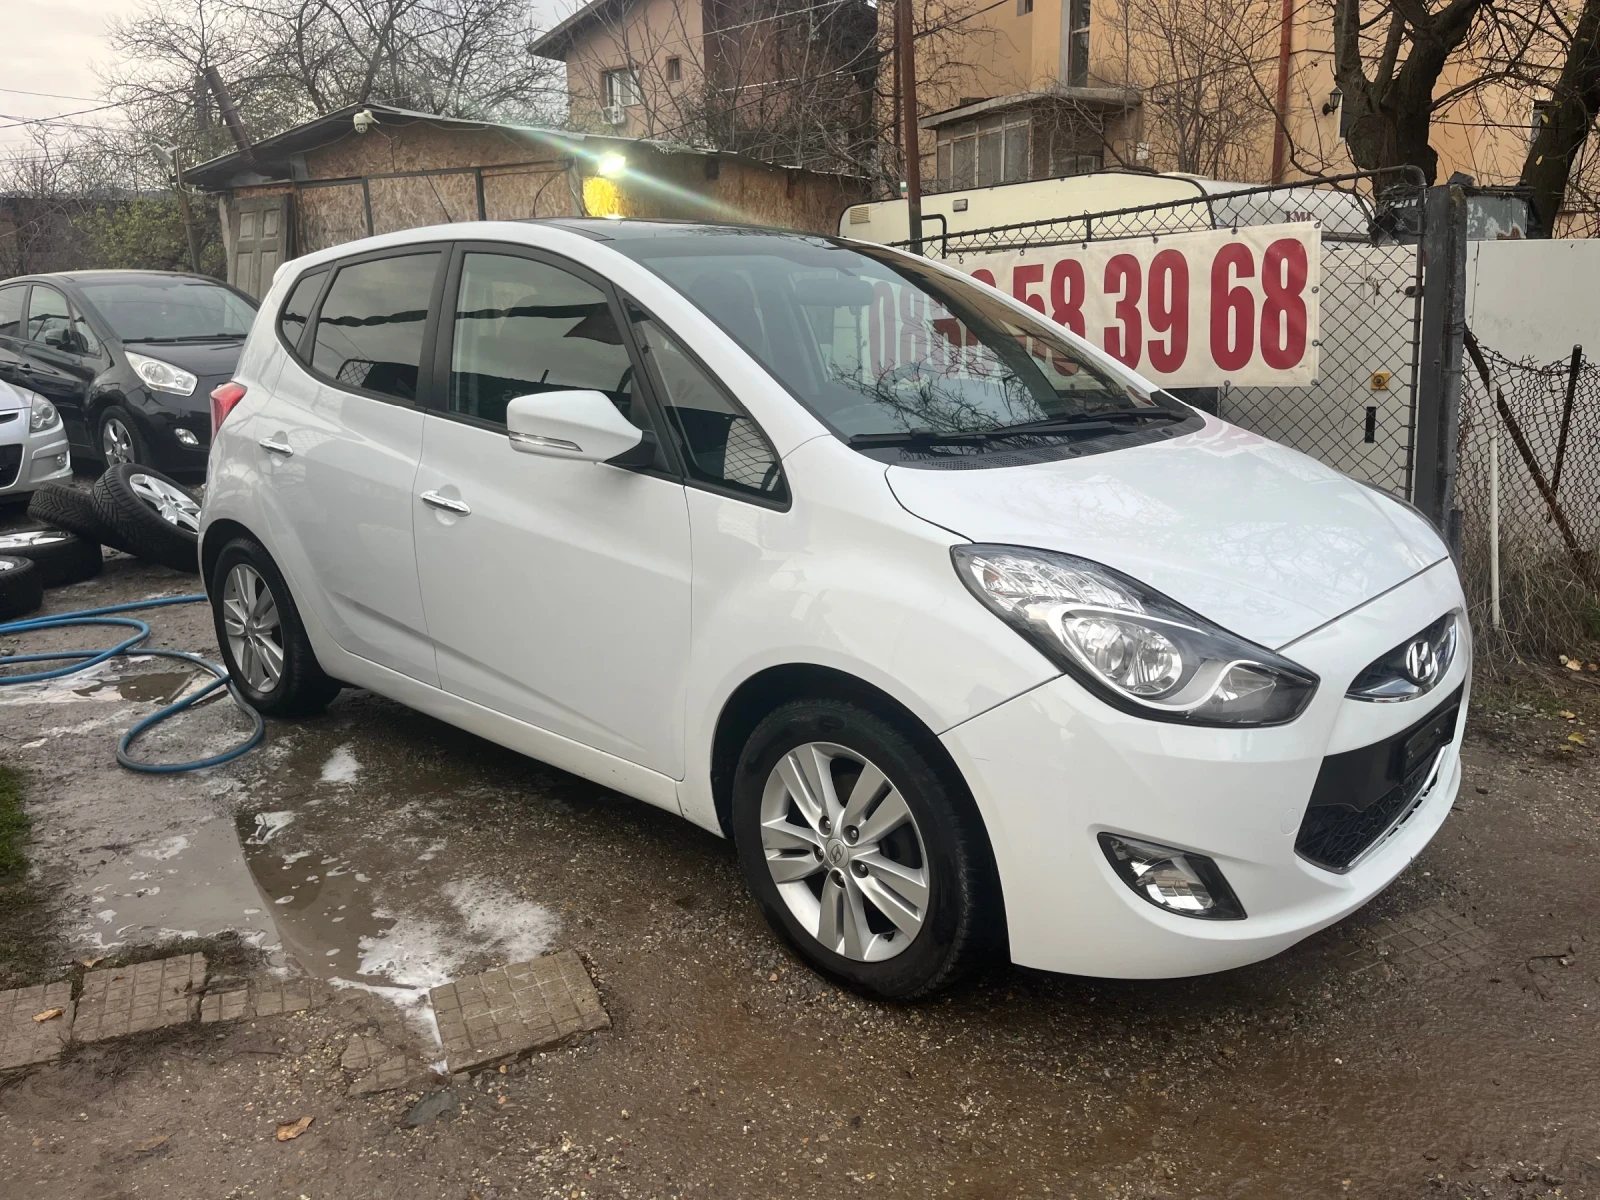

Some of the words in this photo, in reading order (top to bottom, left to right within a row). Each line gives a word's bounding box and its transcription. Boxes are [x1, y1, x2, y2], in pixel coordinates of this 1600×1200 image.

[1013, 259, 1085, 377] 58
[1103, 248, 1189, 373] 39
[1210, 238, 1308, 371] 68
